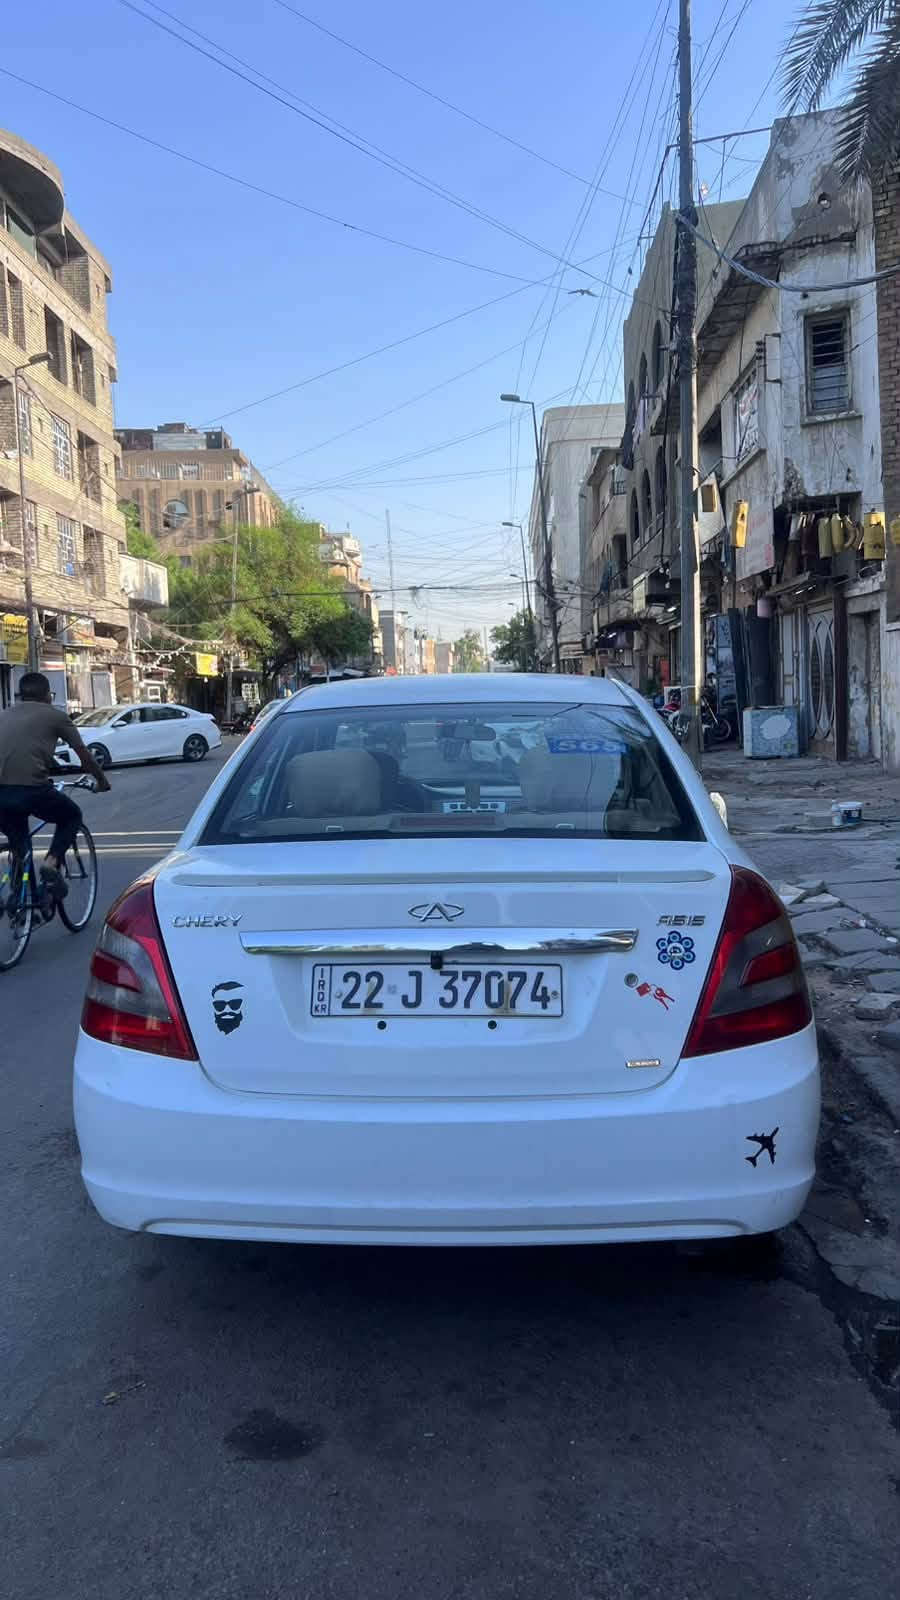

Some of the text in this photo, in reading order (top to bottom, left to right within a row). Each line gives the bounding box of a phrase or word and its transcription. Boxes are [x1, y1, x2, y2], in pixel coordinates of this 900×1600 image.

[172, 913, 243, 928] CHERY
[341, 970, 550, 1010] 22 J 37074
[314, 1003, 327, 1014] KR
